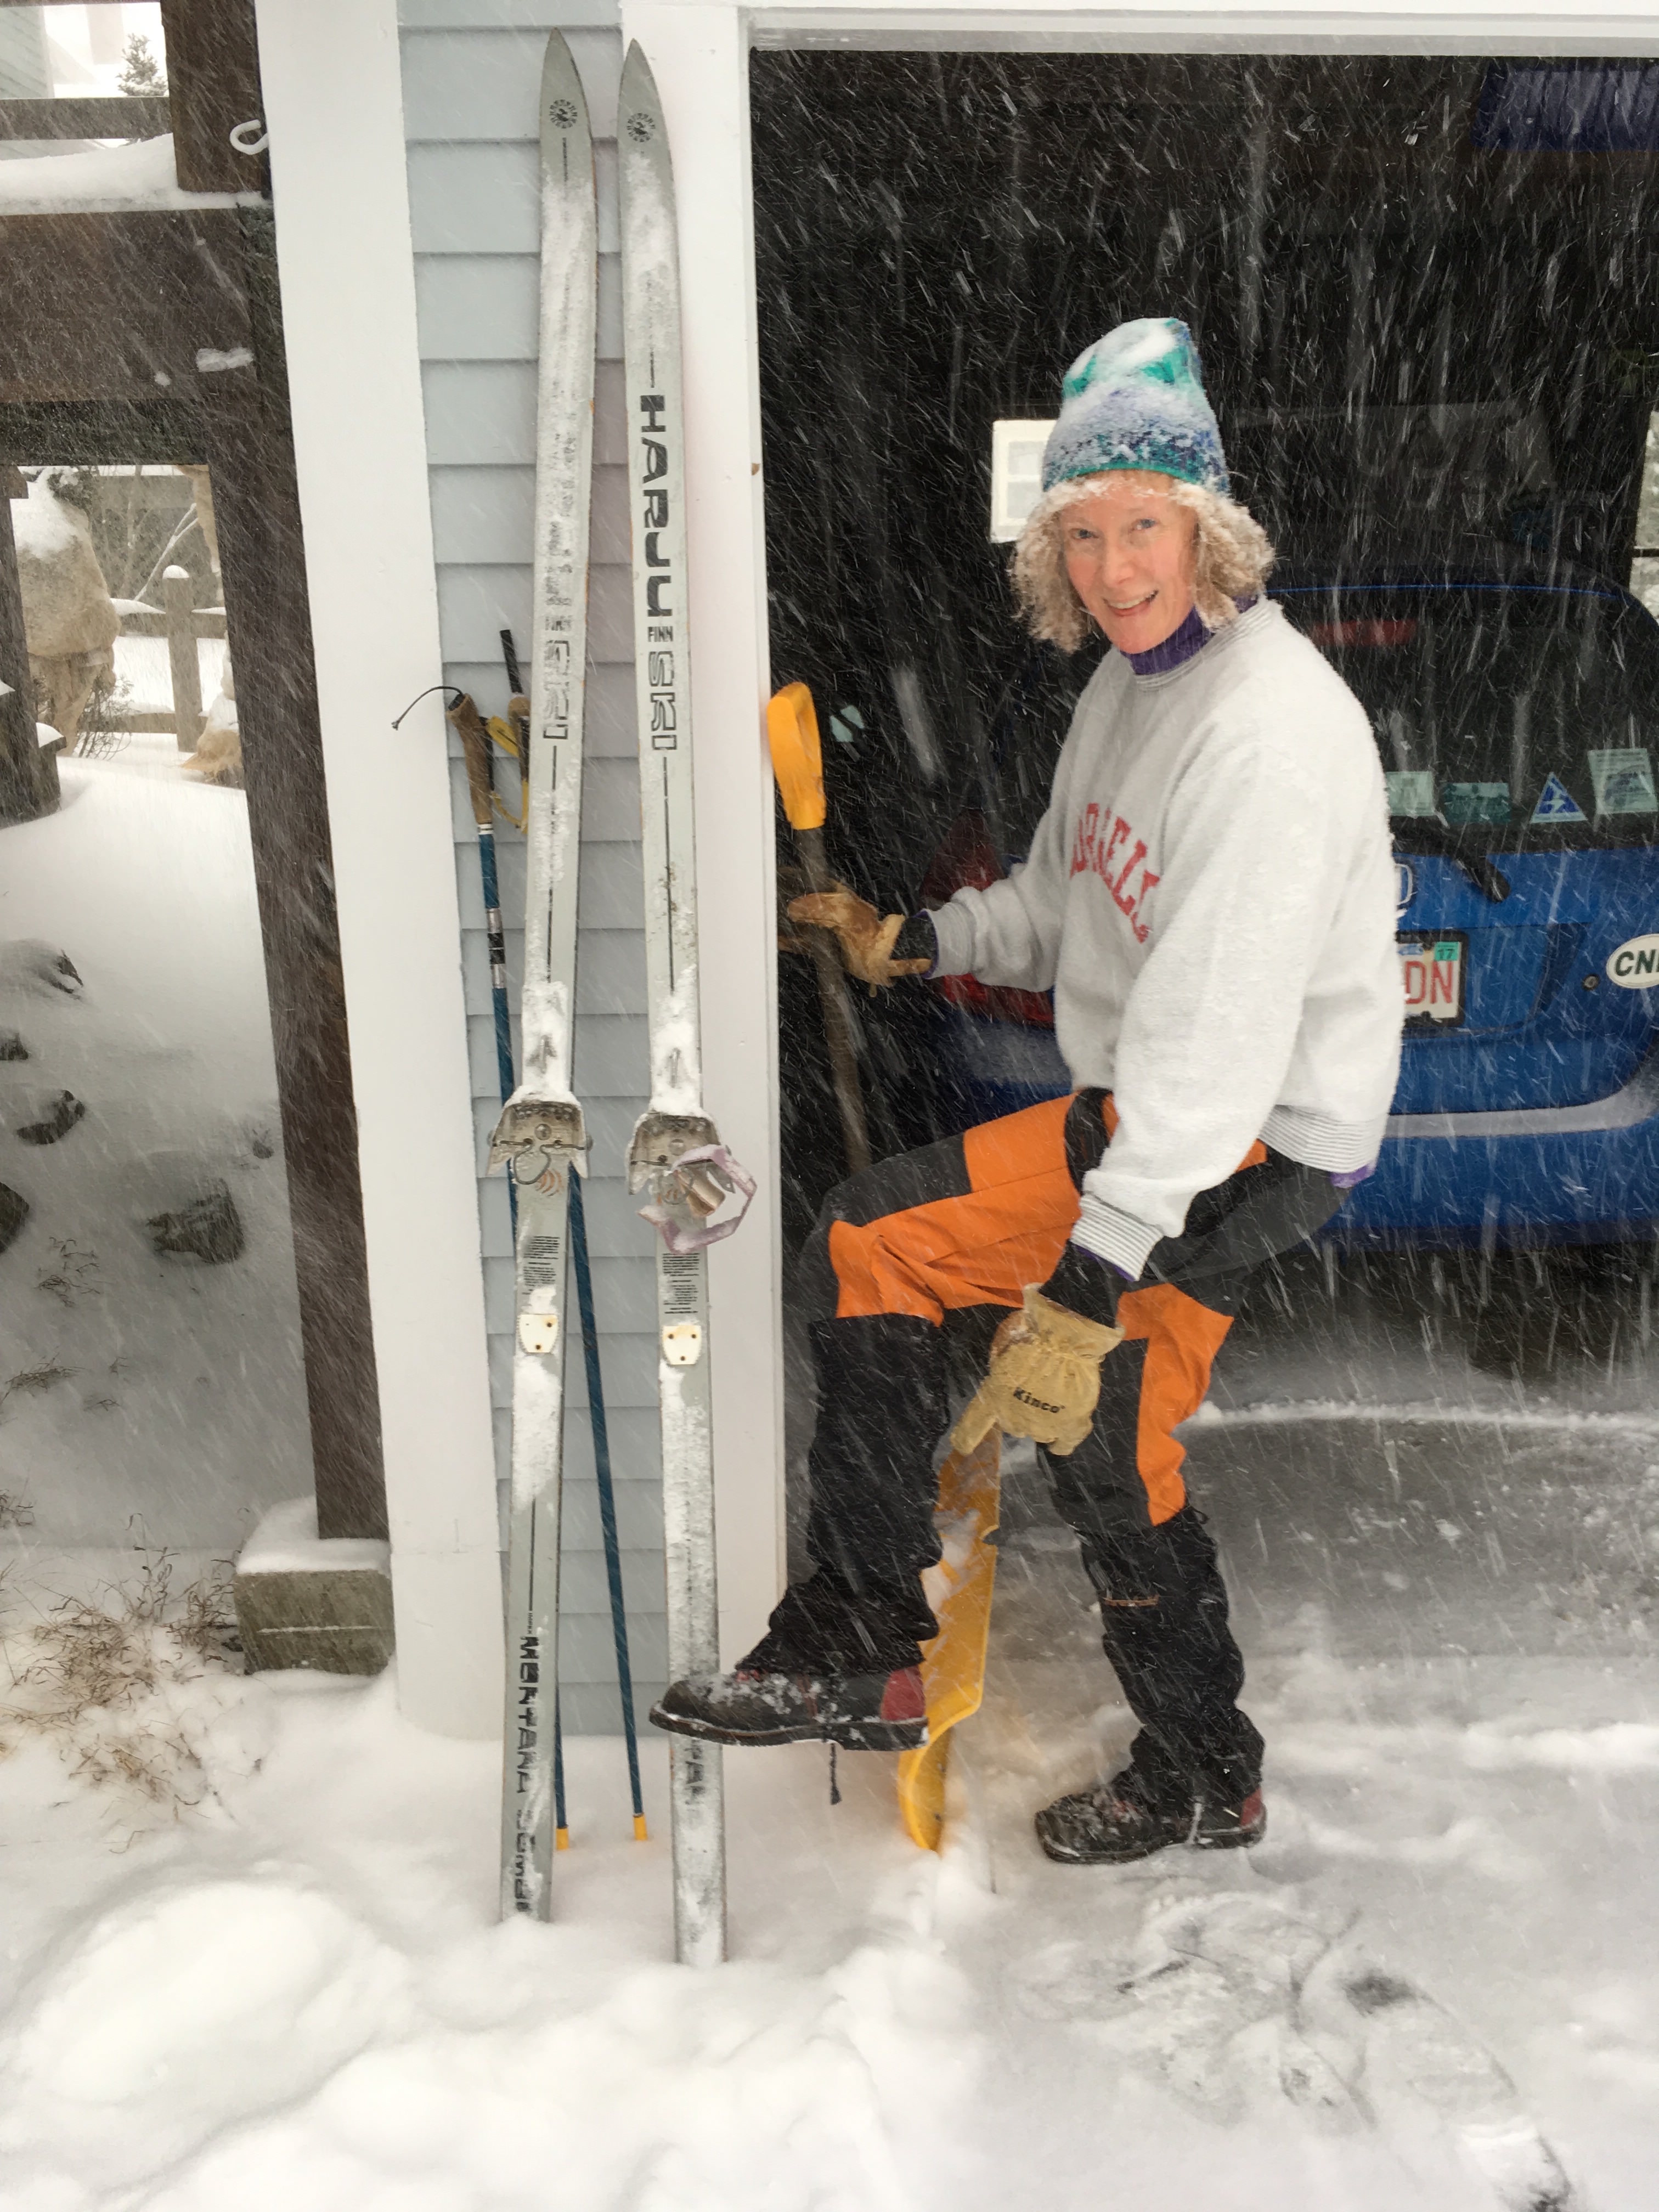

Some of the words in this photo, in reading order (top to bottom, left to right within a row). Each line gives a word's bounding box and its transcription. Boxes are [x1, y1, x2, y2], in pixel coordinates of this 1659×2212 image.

[640, 394, 673, 617] HARJU
[648, 651, 678, 751] SKI
[1615, 949, 1659, 977] CN
[1013, 1387, 1060, 1413] Kinco
[517, 1637, 540, 1793] MONTANA
